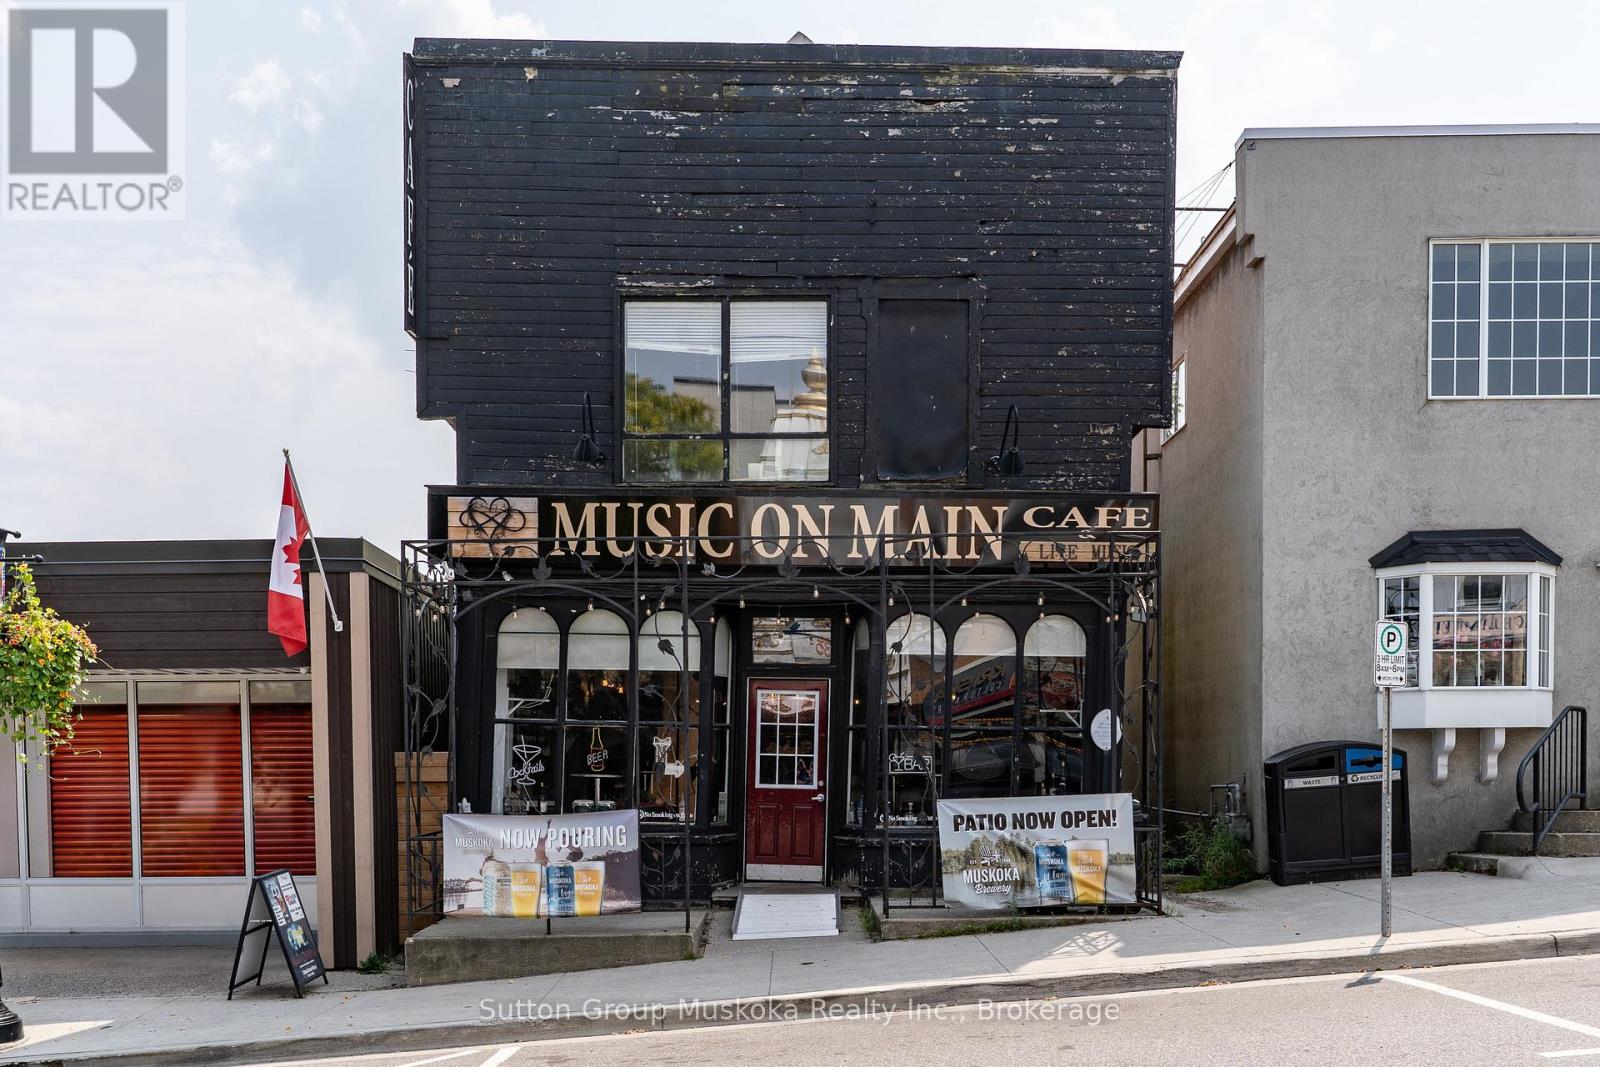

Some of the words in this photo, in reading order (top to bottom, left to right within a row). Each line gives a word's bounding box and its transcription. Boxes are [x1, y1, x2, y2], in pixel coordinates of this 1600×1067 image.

[1023, 506, 1152, 529] CAFE
[551, 502, 734, 558] MUSIC
[751, 503, 835, 558] ON
[847, 504, 1009, 560] MAIN
[1092, 544, 1136, 561] MUSI
[1387, 632, 1396, 647] P
[1376, 654, 1380, 664] 3
[1381, 654, 1390, 664] HR
[1391, 655, 1405, 664] LIMIT
[586, 749, 609, 766] BEER
[903, 758, 931, 771] BAR
[507, 760, 545, 780] Cocktails
[953, 813, 1007, 832] PATIO
[1013, 811, 1056, 830] NOW
[1061, 809, 1117, 828] OPEN!
[455, 838, 494, 848] MUSKOKA
[500, 829, 542, 849] NOW
[548, 824, 627, 849] POURING
[962, 868, 1020, 884] MUSKOKA
[974, 884, 1011, 895] Brewery
